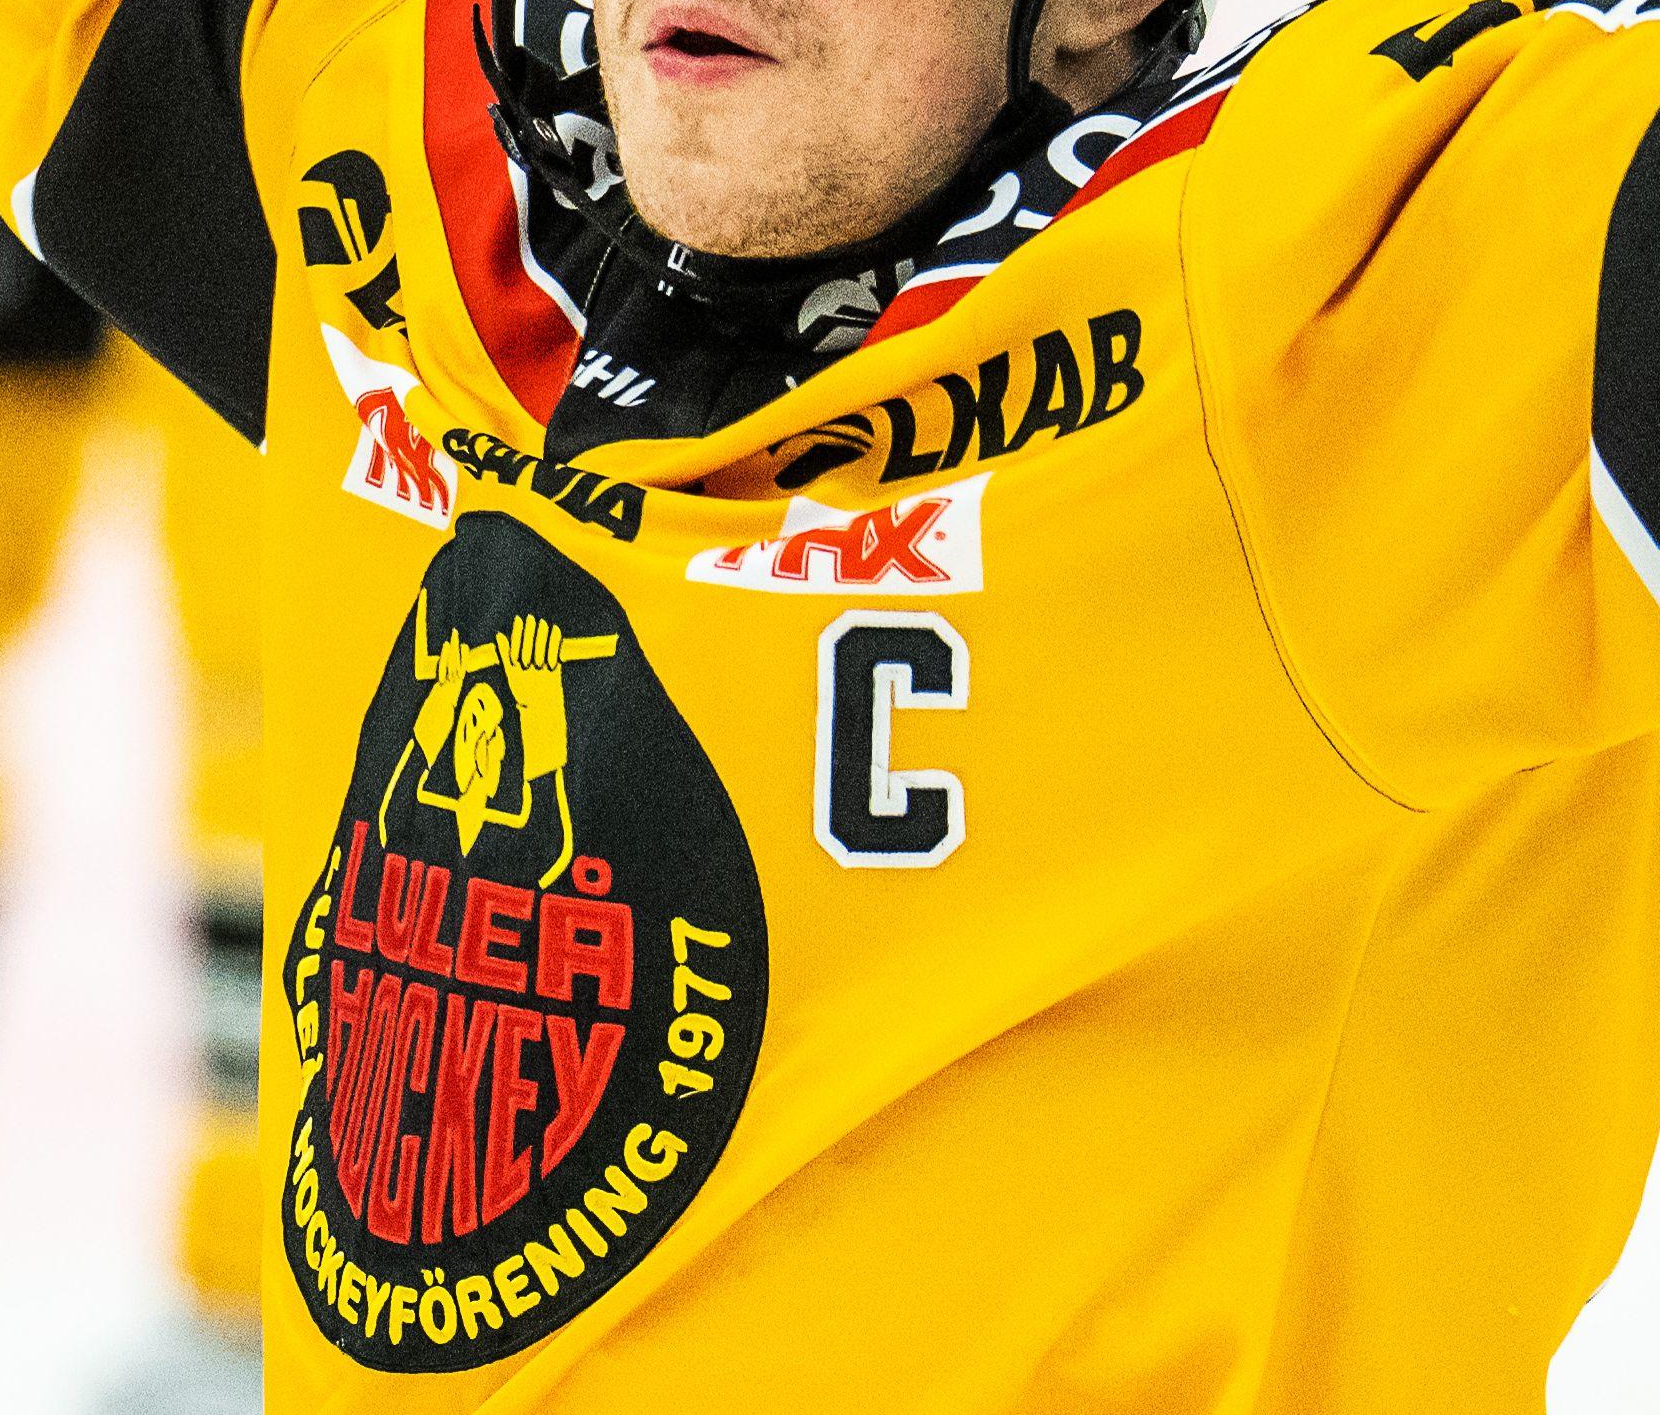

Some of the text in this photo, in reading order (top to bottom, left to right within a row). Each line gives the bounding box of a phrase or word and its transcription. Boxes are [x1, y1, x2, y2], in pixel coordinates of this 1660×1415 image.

[879, 308, 1146, 484] LKAB
[814, 609, 970, 869] C
[334, 819, 635, 1011] LULEÅ
[293, 1116, 689, 1346] HOCKEYFÖRENING
[657, 916, 733, 1097] 1977
[326, 959, 627, 1246] HOCKEY
